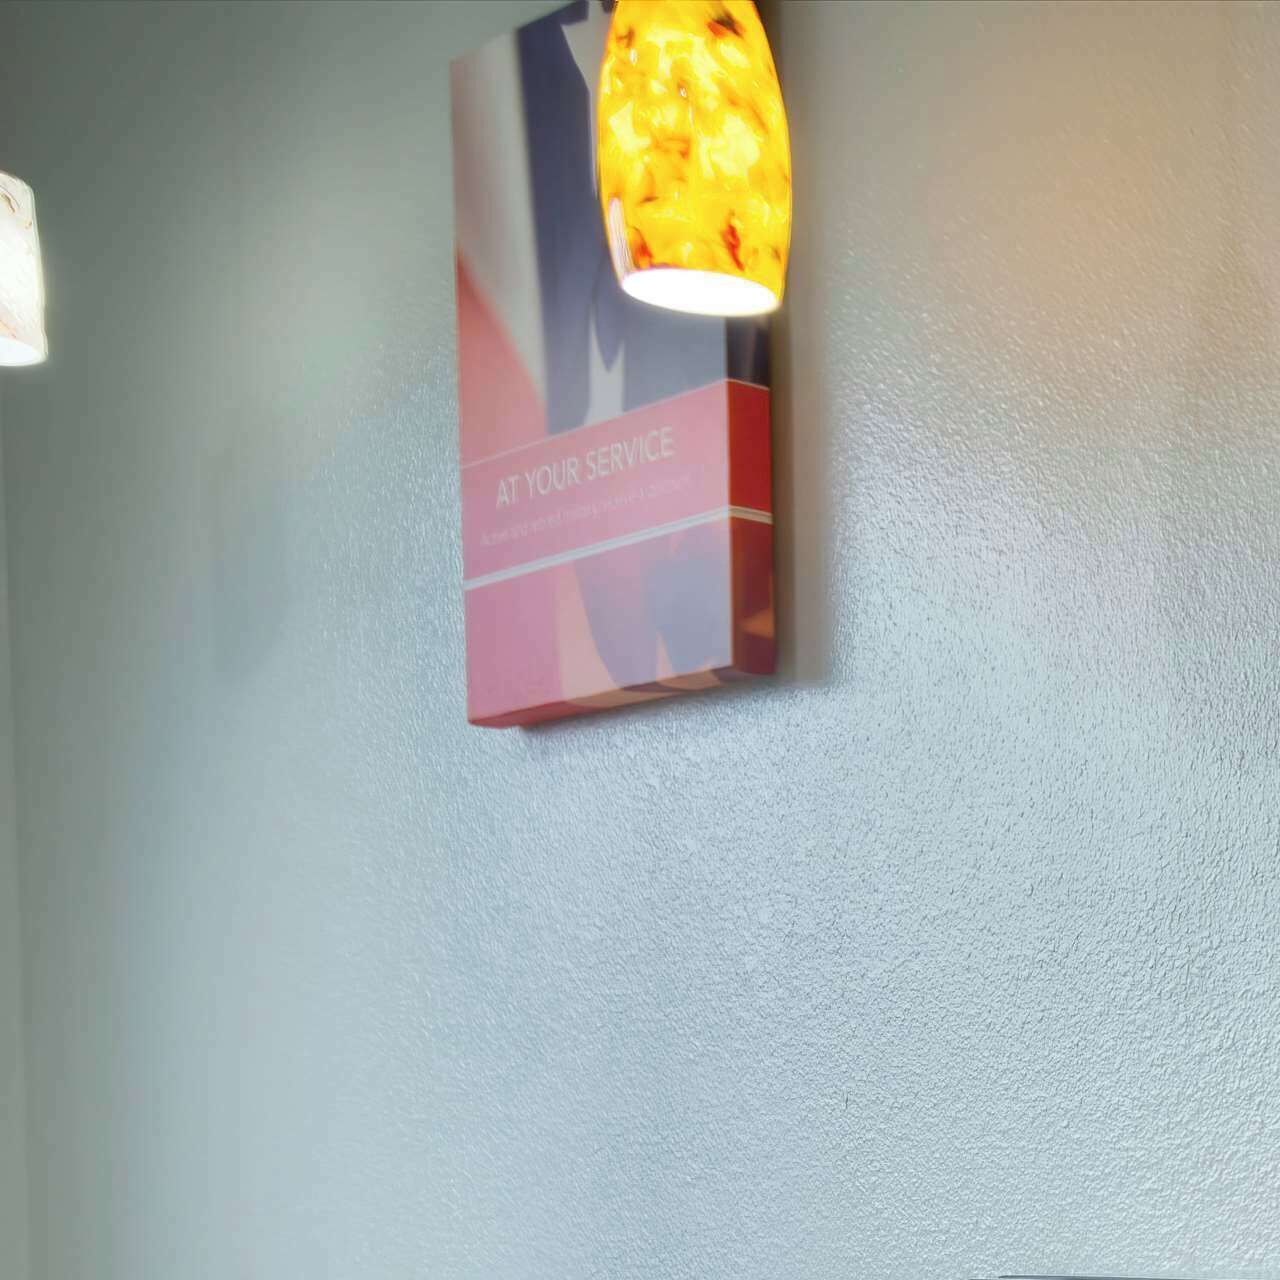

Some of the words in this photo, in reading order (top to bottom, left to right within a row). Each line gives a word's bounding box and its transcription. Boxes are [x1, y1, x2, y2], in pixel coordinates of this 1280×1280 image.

[496, 474, 521, 507] AT
[525, 457, 581, 498] YOUR
[586, 426, 674, 482] SERVICE
